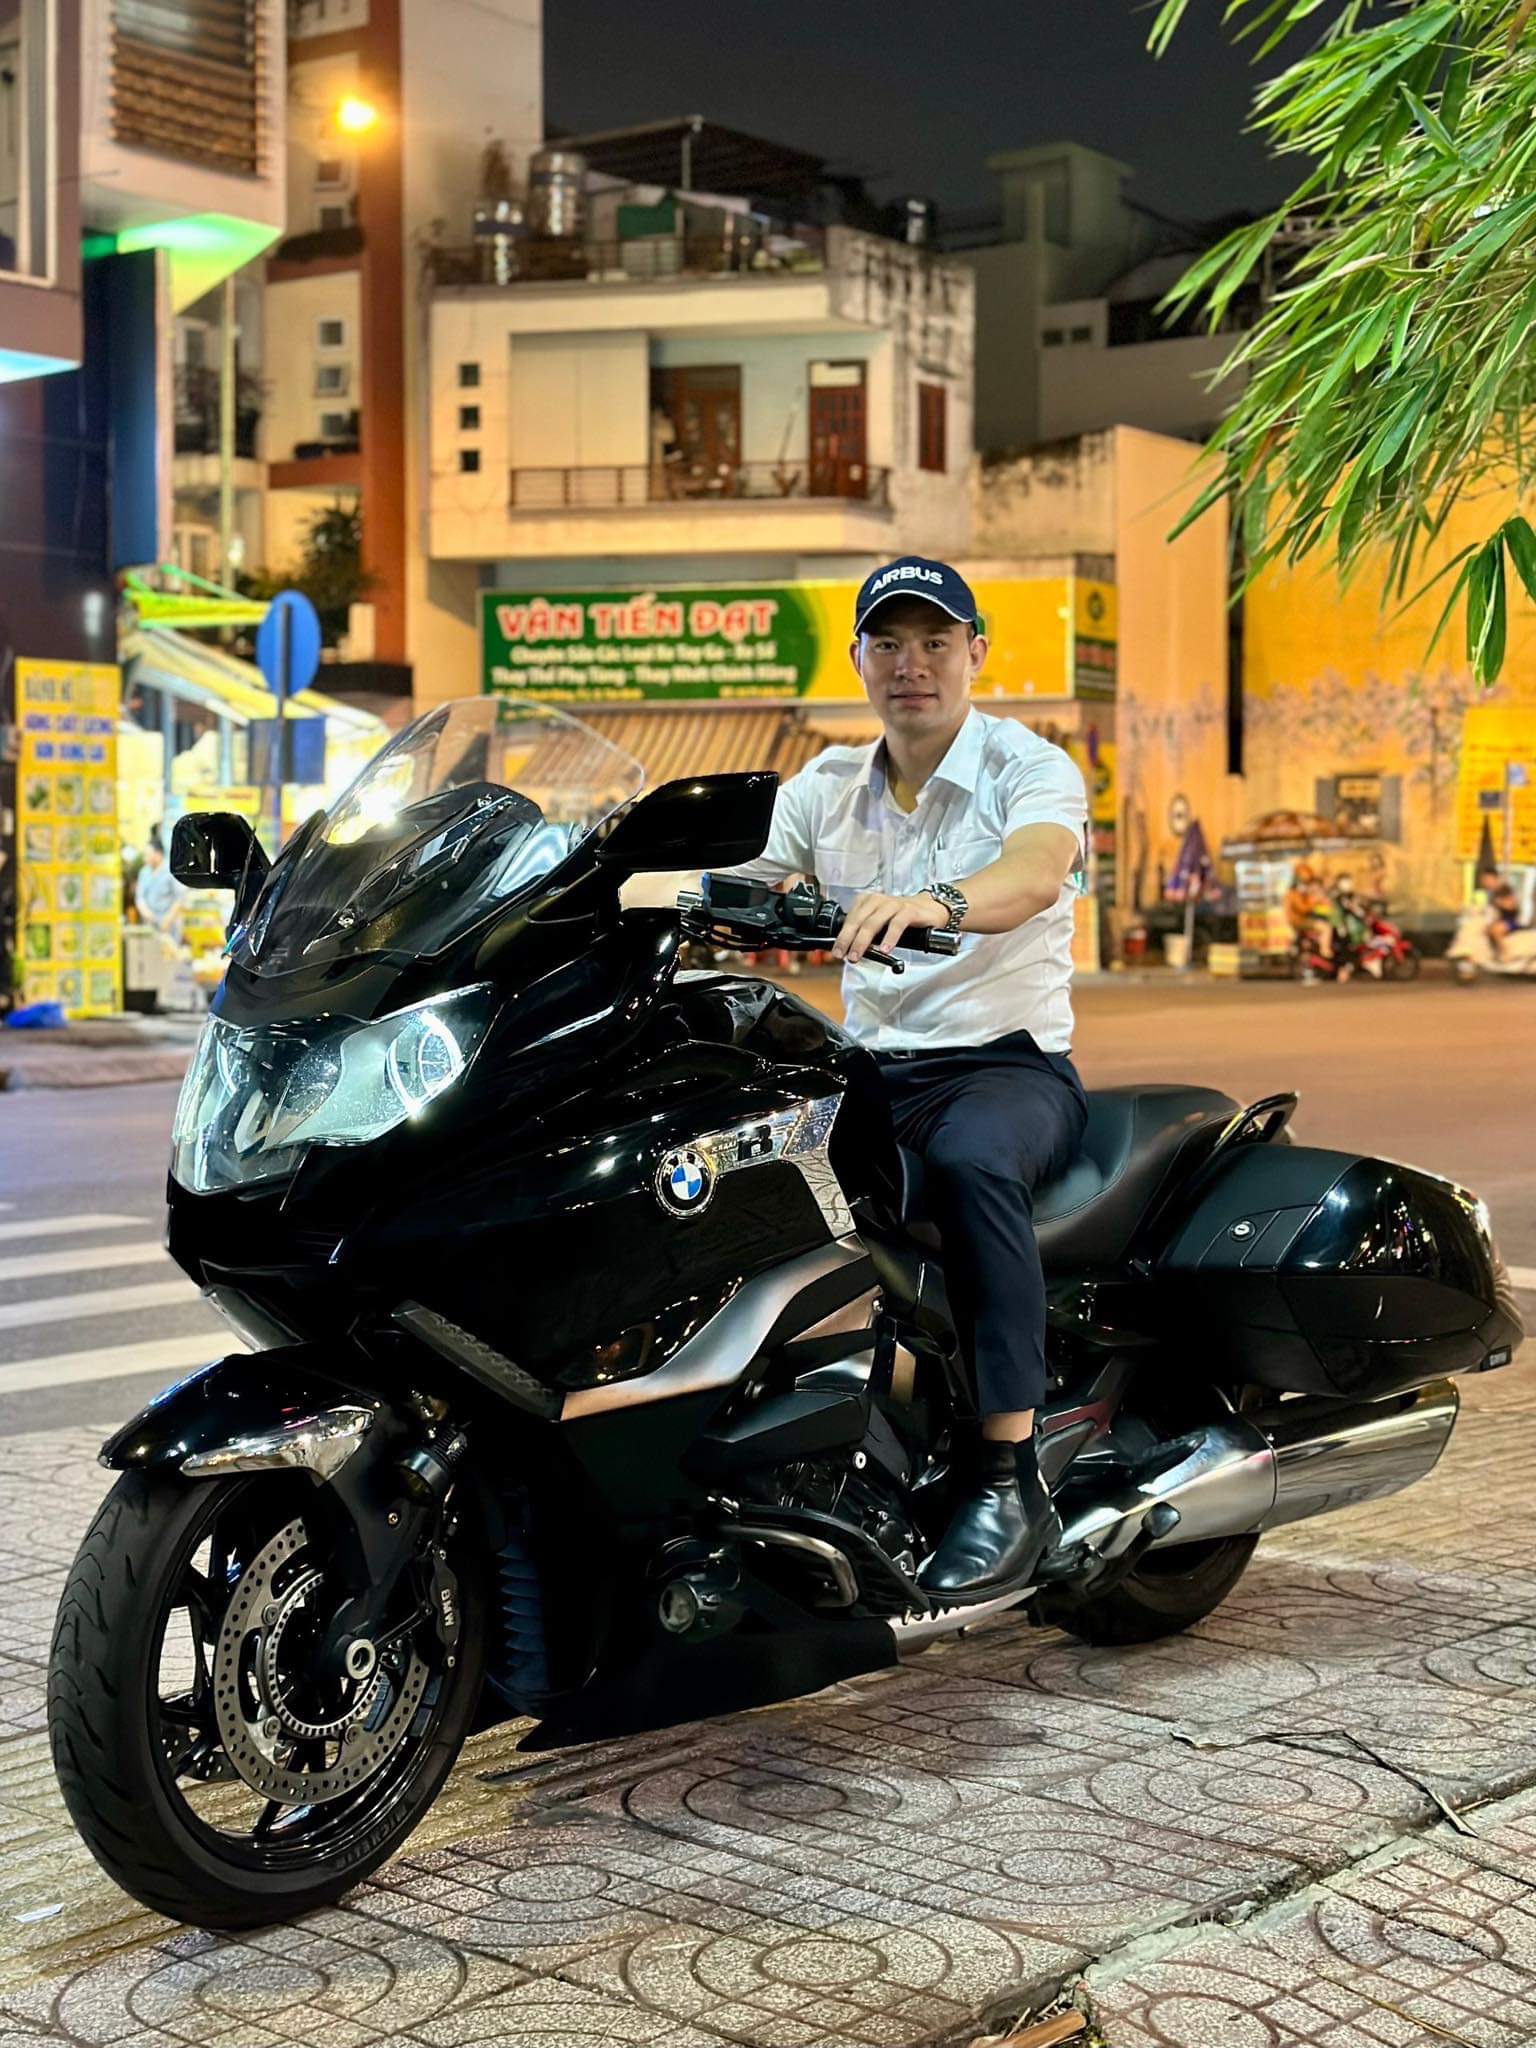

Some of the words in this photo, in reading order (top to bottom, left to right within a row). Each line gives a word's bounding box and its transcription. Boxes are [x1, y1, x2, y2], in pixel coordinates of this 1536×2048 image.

[870, 566, 944, 595] AIRBUS
[587, 591, 684, 639] TIẾN
[688, 599, 779, 645] ĐẠT
[441, 1588, 455, 1627] BMW
